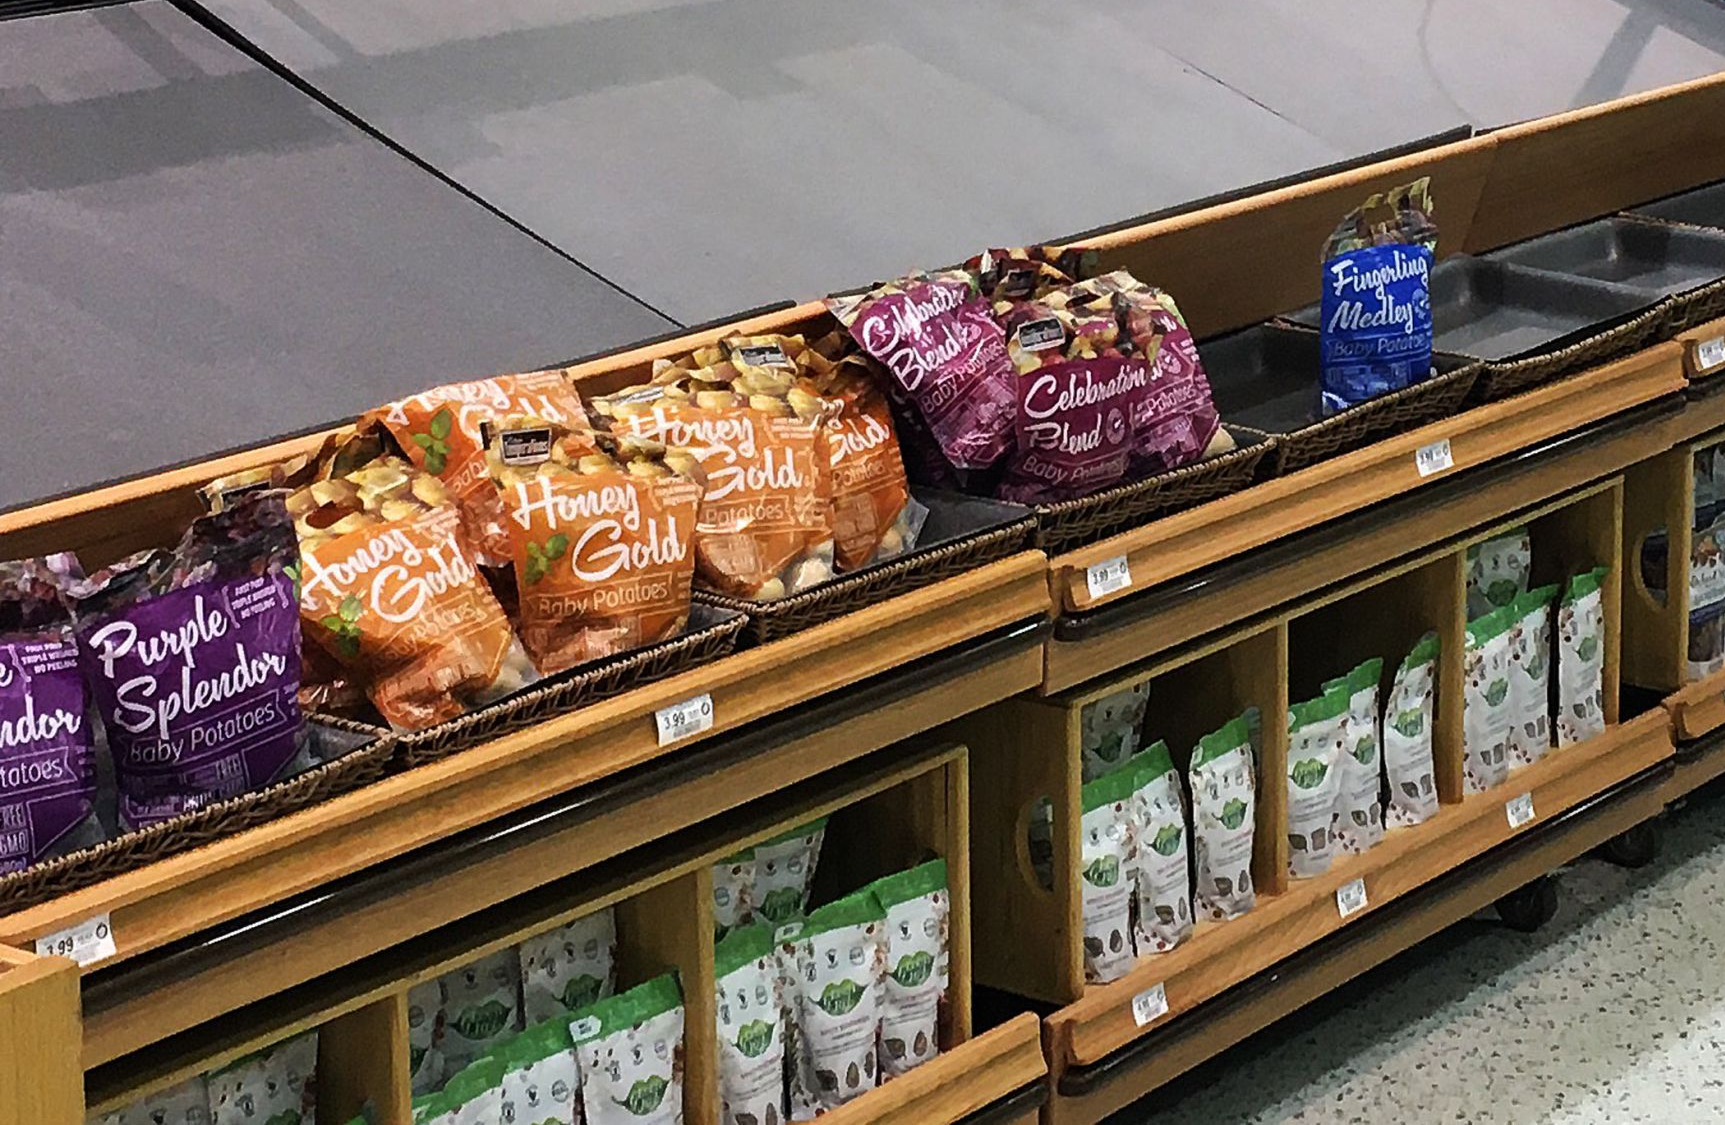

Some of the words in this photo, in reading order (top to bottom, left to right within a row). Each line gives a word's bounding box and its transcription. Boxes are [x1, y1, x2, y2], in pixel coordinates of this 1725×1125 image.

[1331, 250, 1429, 300] Fingerling
[1328, 294, 1414, 334] Medley
[889, 326, 962, 392] Blend
[1335, 340, 1377, 360] Baby
[920, 374, 957, 414] Baby
[1023, 369, 1148, 419] Celebration
[625, 405, 756, 460] Honey
[1023, 420, 1104, 456] Blend
[689, 446, 804, 502] Gold
[512, 476, 641, 533] Honey
[704, 500, 786, 525] Potatoes
[299, 527, 423, 611] Honey
[571, 517, 687, 583] Gold
[370, 532, 479, 623] Gold
[537, 588, 588, 616] Baby
[592, 583, 670, 610] Potatoes
[1092, 568, 1109, 585] 3.99
[89, 595, 229, 679] Purple
[113, 642, 286, 741] Splendor
[0, 693, 81, 749] ndor
[130, 738, 184, 764] Baby
[191, 702, 276, 752] Potatoes
[664, 710, 686, 731] 3.99
[0, 758, 63, 788] tatoes
